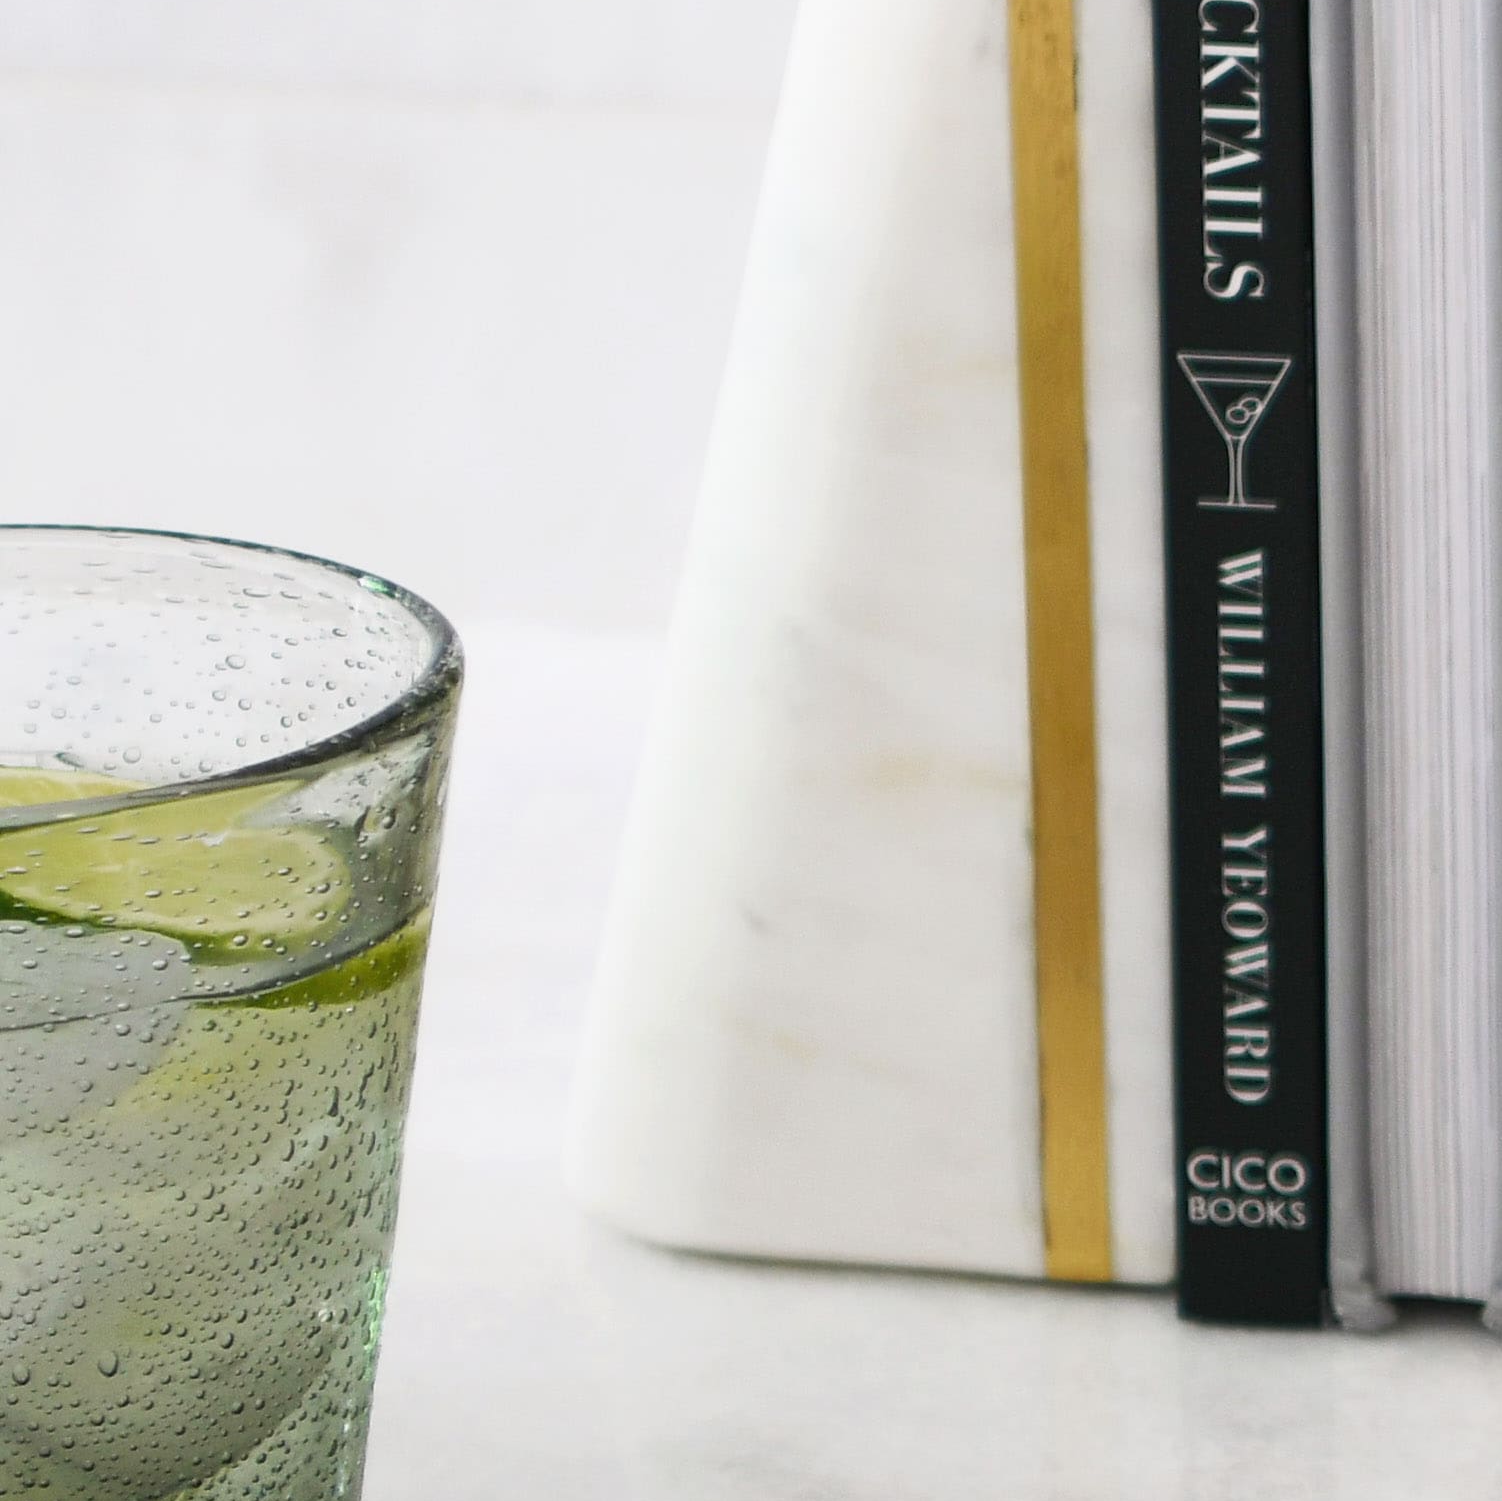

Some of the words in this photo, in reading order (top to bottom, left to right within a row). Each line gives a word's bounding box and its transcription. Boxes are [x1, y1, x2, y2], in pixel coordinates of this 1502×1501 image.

[1218, 550, 1266, 796] WILLIAM
[1222, 829, 1271, 1103] YEOWARD
[1187, 1154, 1306, 1193] CICO
[1188, 1196, 1306, 1228] BOOKS
